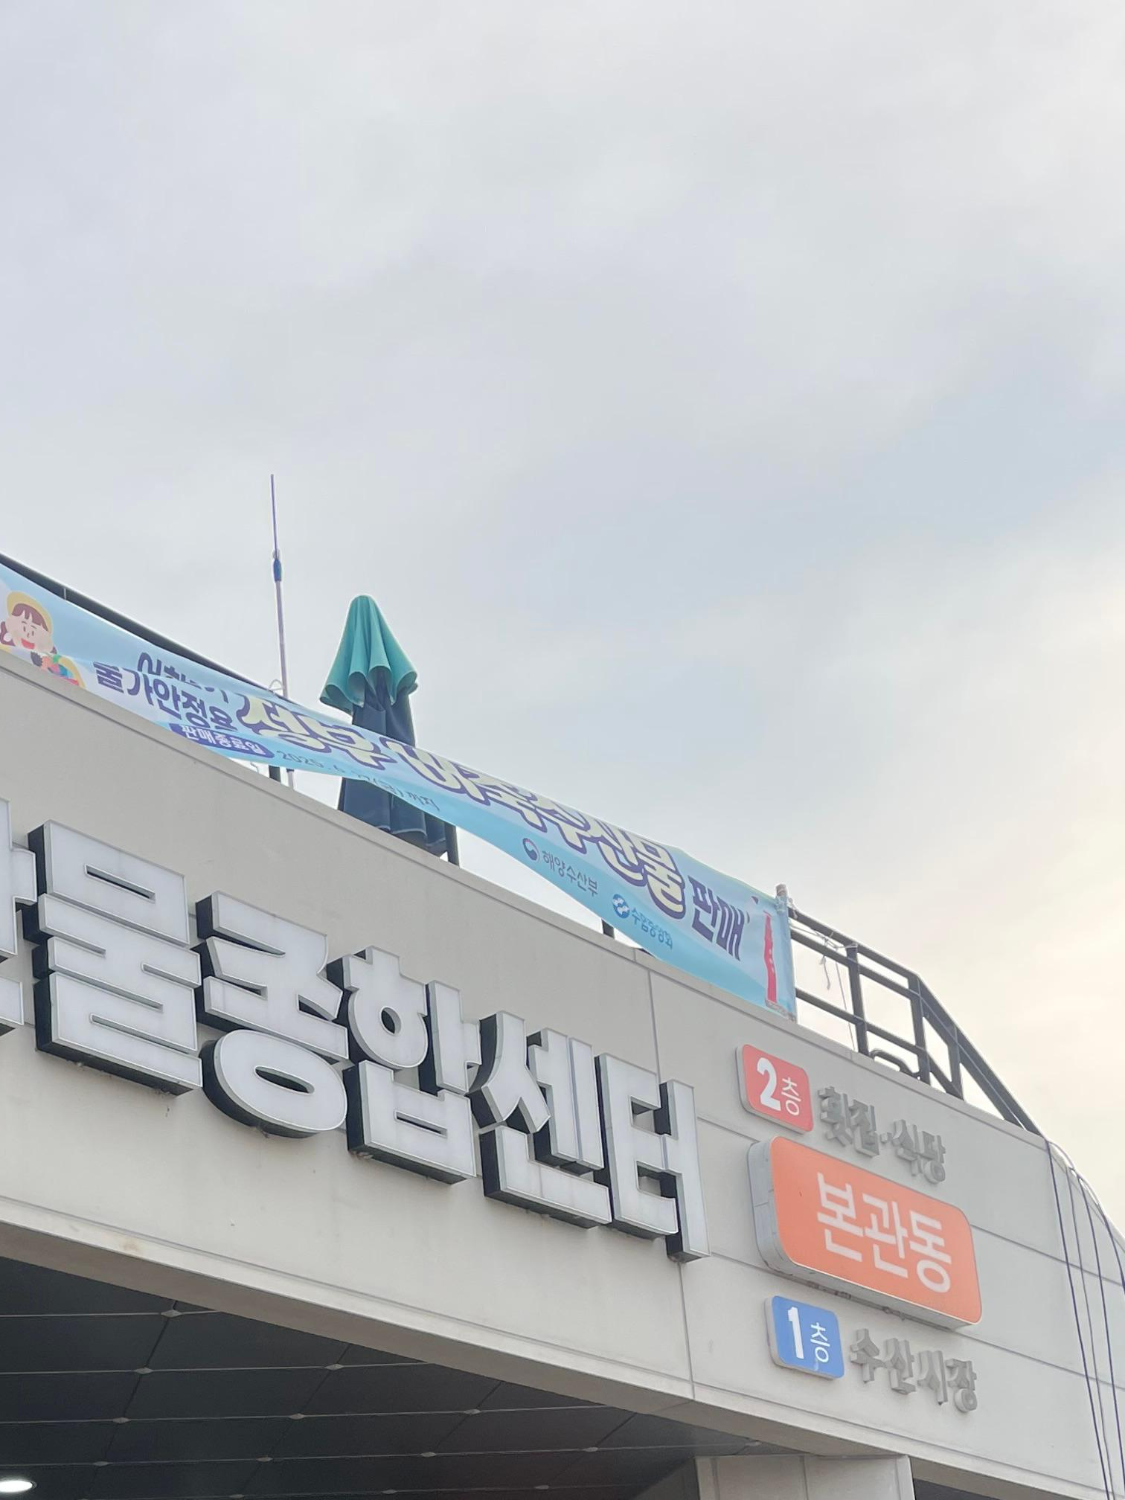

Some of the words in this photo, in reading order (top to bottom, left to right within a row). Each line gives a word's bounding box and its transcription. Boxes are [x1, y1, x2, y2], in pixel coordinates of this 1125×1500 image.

[541, 850, 598, 898] 해양수산부
[687, 875, 744, 961] 판매
[757, 1057, 800, 1116] 2층
[817, 1172, 952, 1293] 본관동
[787, 1307, 831, 1364] 1층
[850, 1329, 978, 1414] 수산시장
